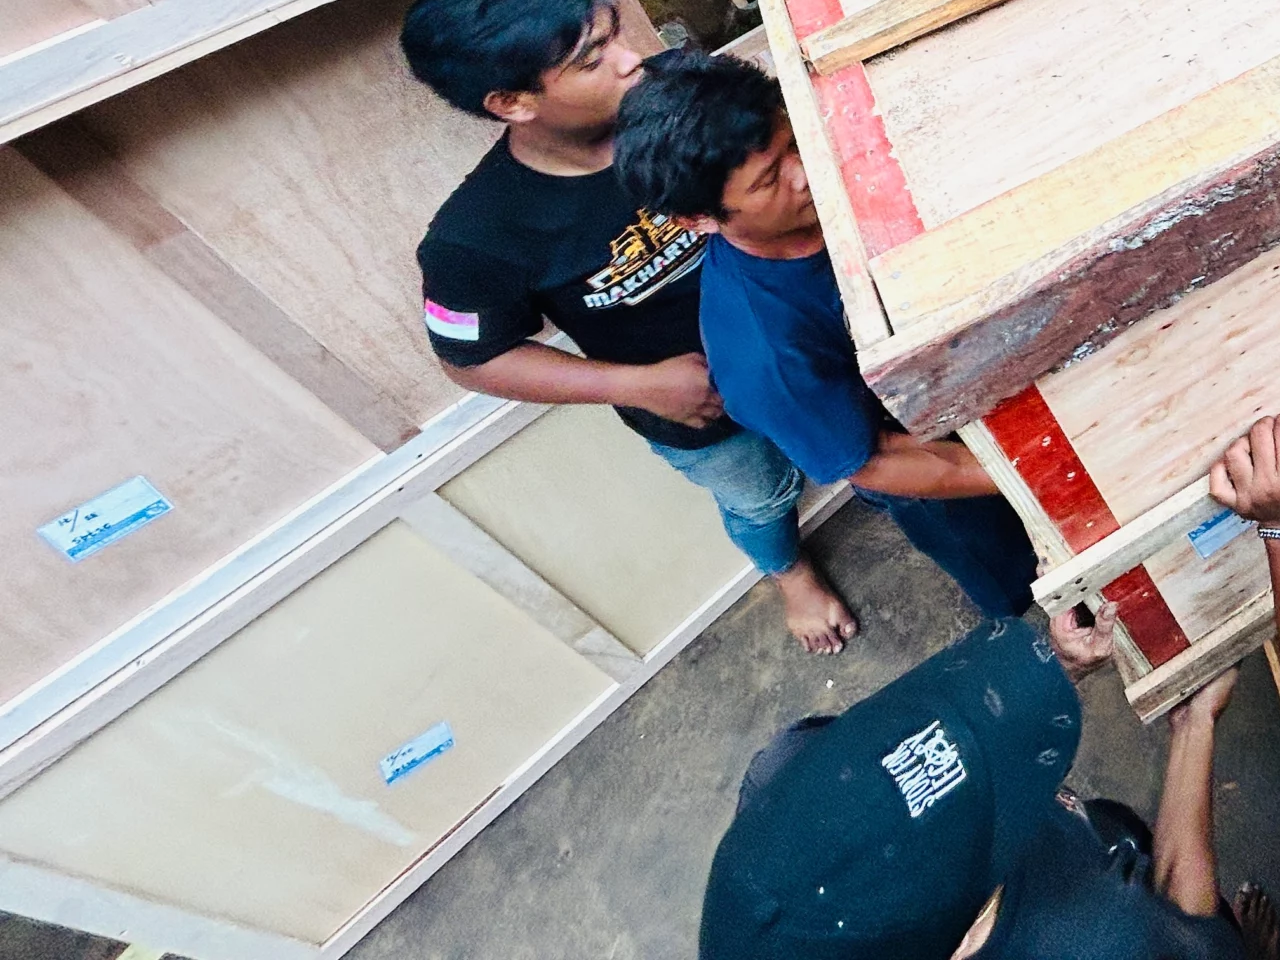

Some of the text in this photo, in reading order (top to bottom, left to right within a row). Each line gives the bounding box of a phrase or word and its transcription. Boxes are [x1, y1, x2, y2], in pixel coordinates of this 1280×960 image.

[881, 741, 936, 818] STORY FOR
[903, 719, 967, 800] LEGACY
